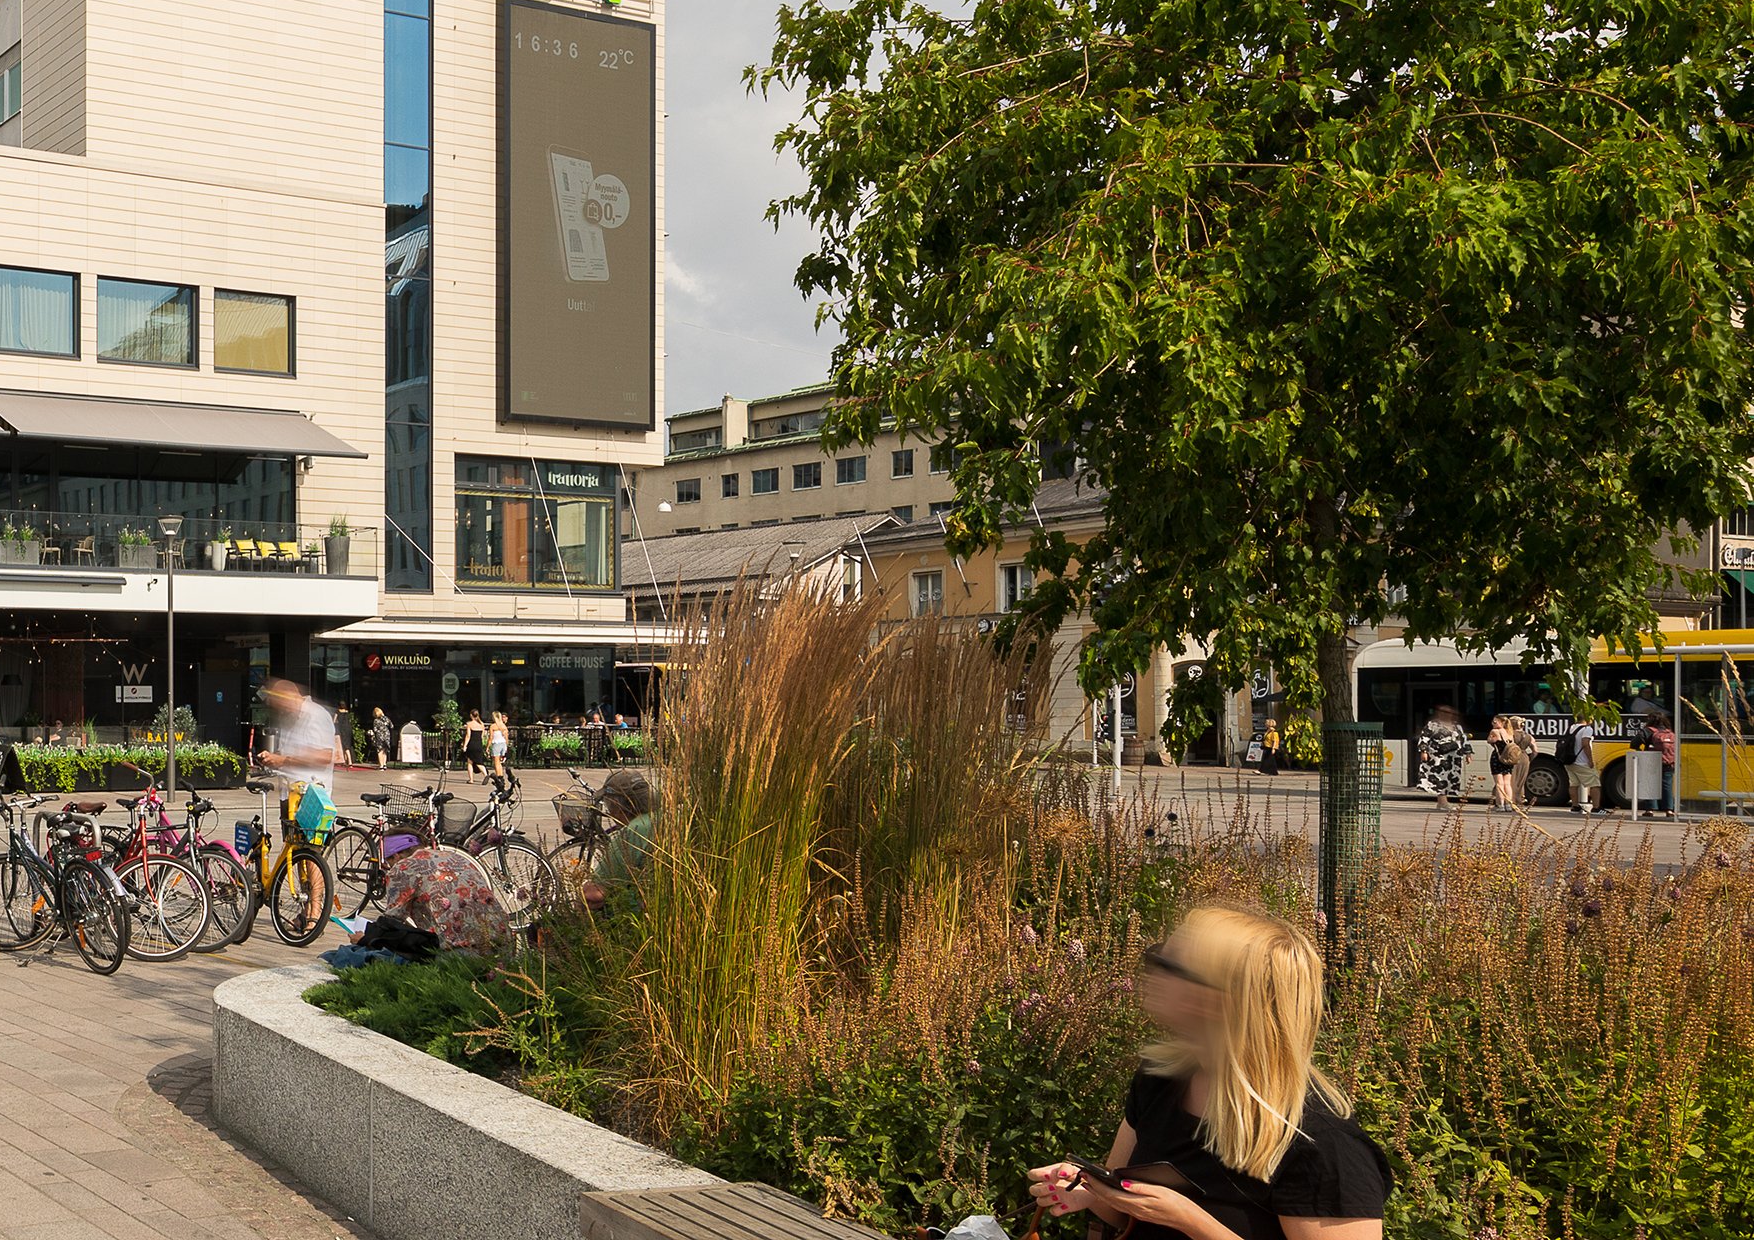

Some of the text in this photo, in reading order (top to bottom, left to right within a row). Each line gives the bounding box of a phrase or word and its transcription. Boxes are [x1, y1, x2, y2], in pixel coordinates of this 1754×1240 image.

[548, 471, 600, 488] trattoria
[538, 656, 605, 669] COFFEE HOUSE
[122, 663, 149, 685] W
